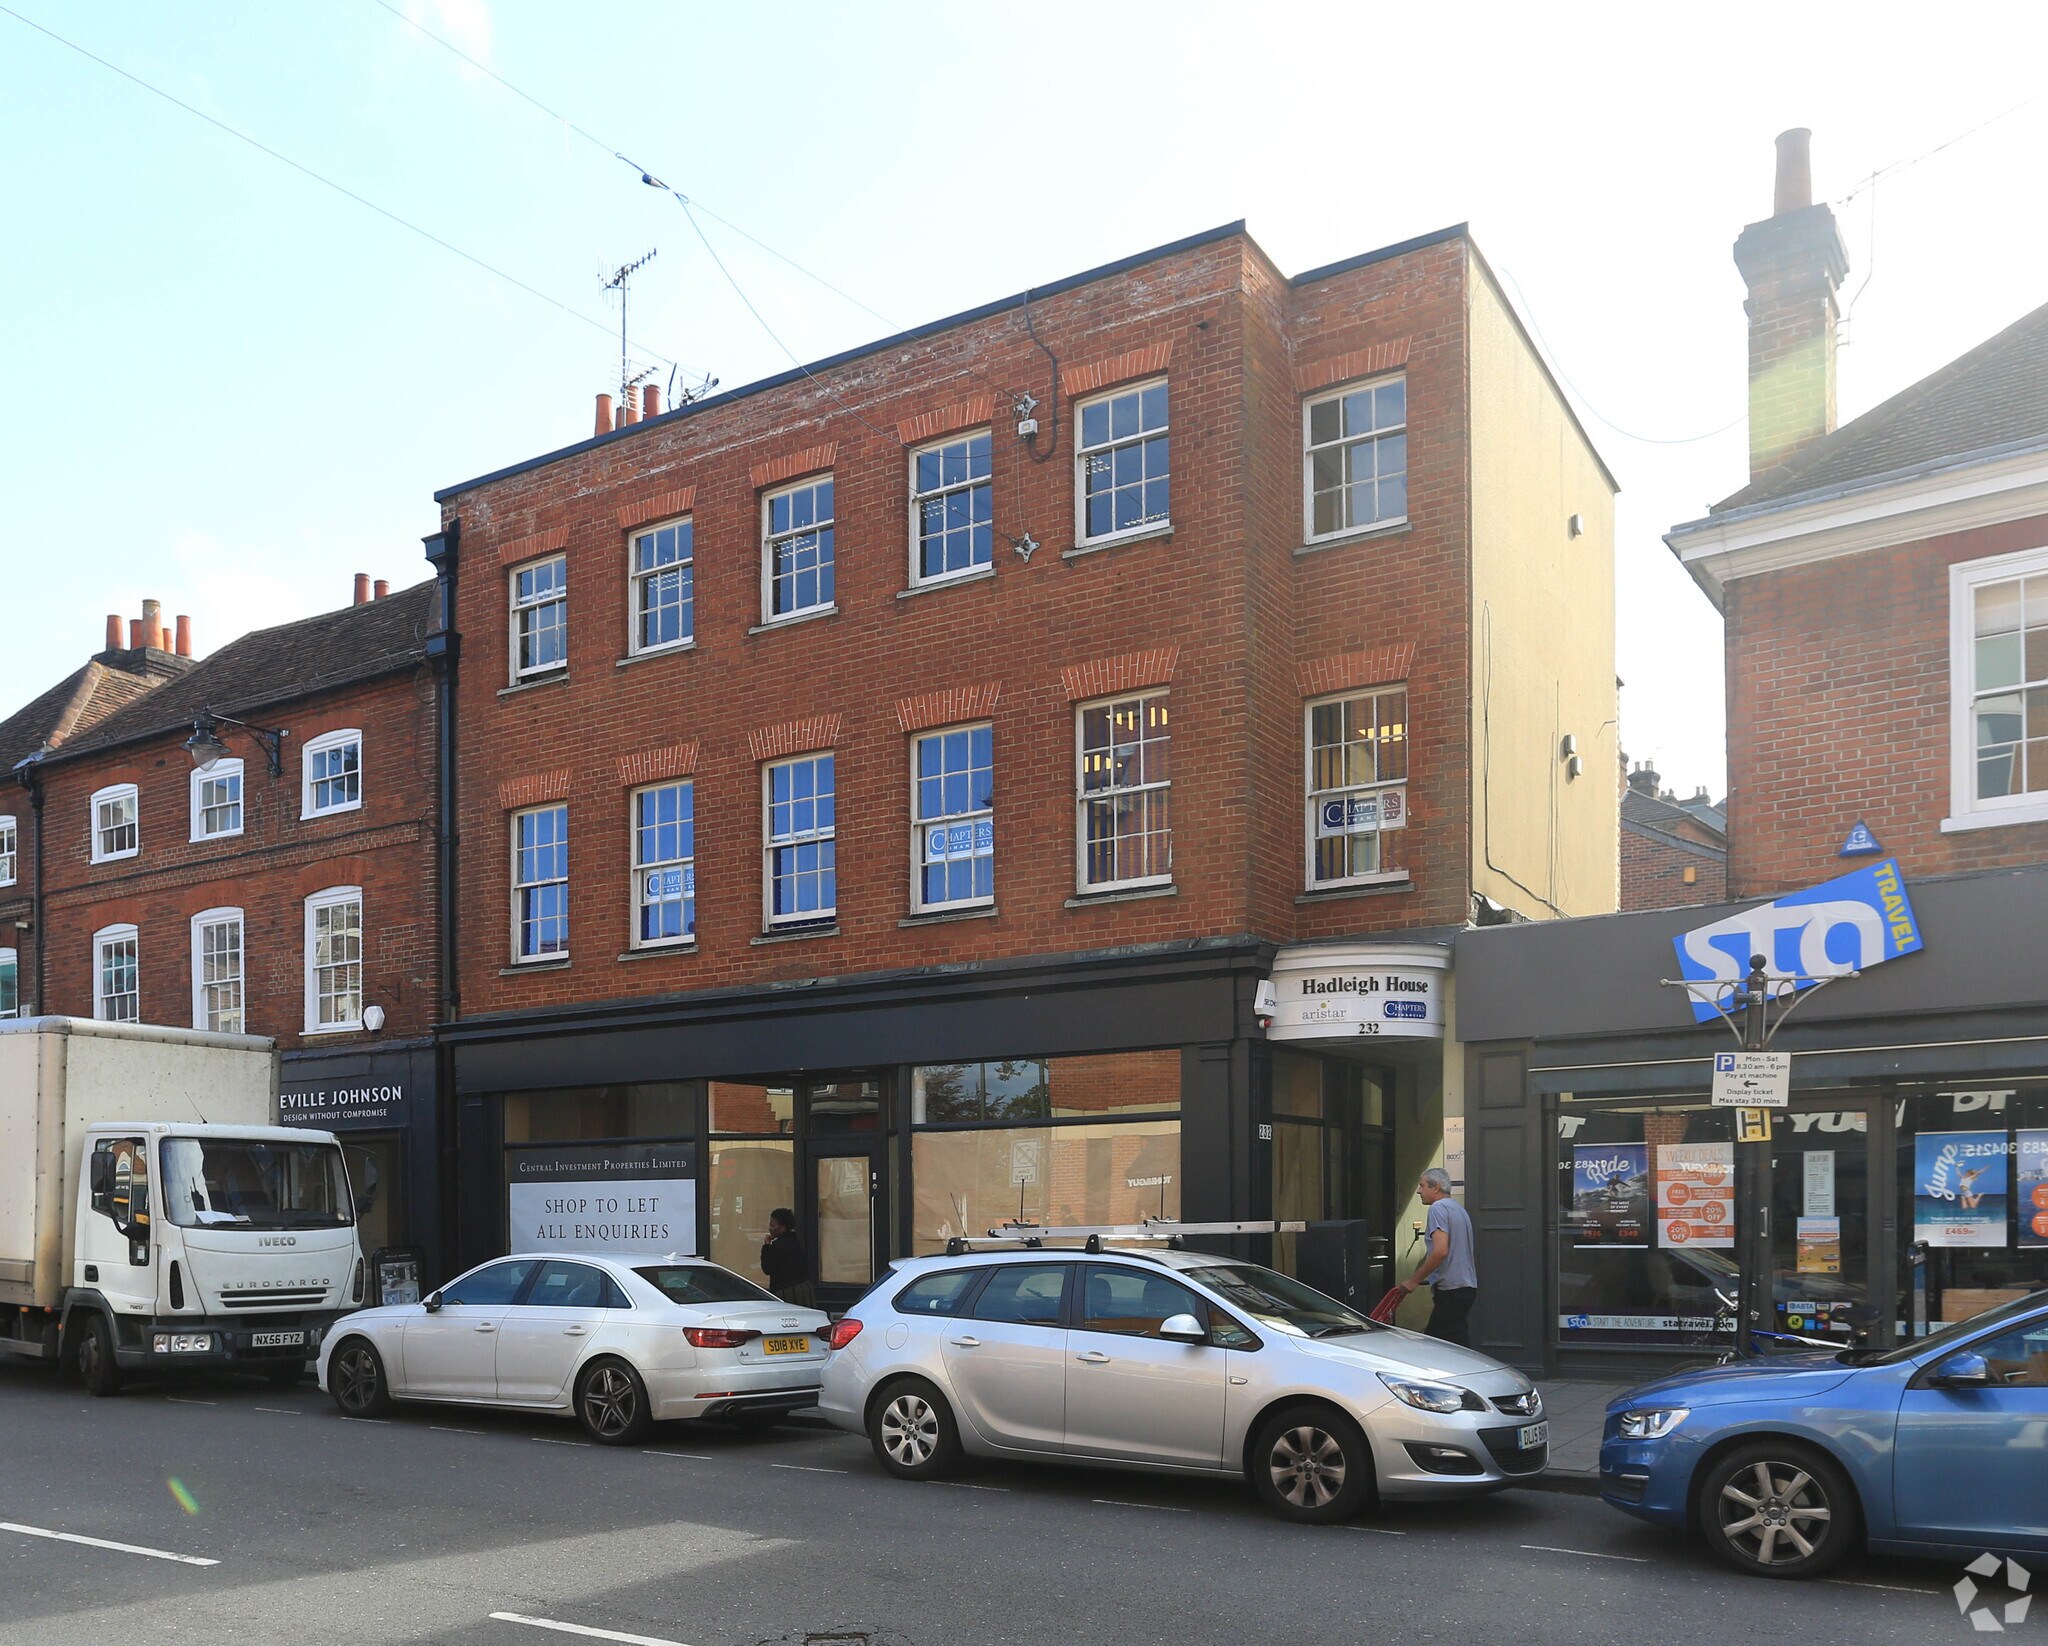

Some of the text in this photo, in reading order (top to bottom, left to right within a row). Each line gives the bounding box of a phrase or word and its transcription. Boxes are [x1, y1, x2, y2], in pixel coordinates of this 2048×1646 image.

[1873, 862, 1916, 952] TRAVEL
[1302, 976, 1429, 996] Hadleigh House
[1302, 1004, 1347, 1020] aristar
[1384, 1003, 1426, 1016] CHAPTERS
[1359, 1023, 1380, 1034] 232
[1720, 1056, 1733, 1071] P
[280, 1085, 402, 1109] EVILLE JOHNSON
[283, 1108, 388, 1122] DESIGN WITHOUT COMPROMISE
[1260, 1124, 1272, 1139] 232
[1665, 1147, 1724, 1163] WEEKLY DEALS
[519, 1158, 687, 1173] CENTRAL INVESTMENT PROPERTIES LIMITED
[1586, 1155, 1631, 1185] Ride
[1924, 1144, 1958, 1201] Jump
[545, 1197, 659, 1213] SHOP TO LET
[536, 1223, 670, 1241] ALL ENQUIRIES
[258, 1237, 297, 1247] IVECO
[222, 1278, 330, 1289] EUROCARGO
[1569, 1315, 1734, 1329] sta START THE ADVENTURE statravel.om
[255, 1333, 300, 1345] NX56 FYZ
[768, 1338, 805, 1352] SD18 XYE
